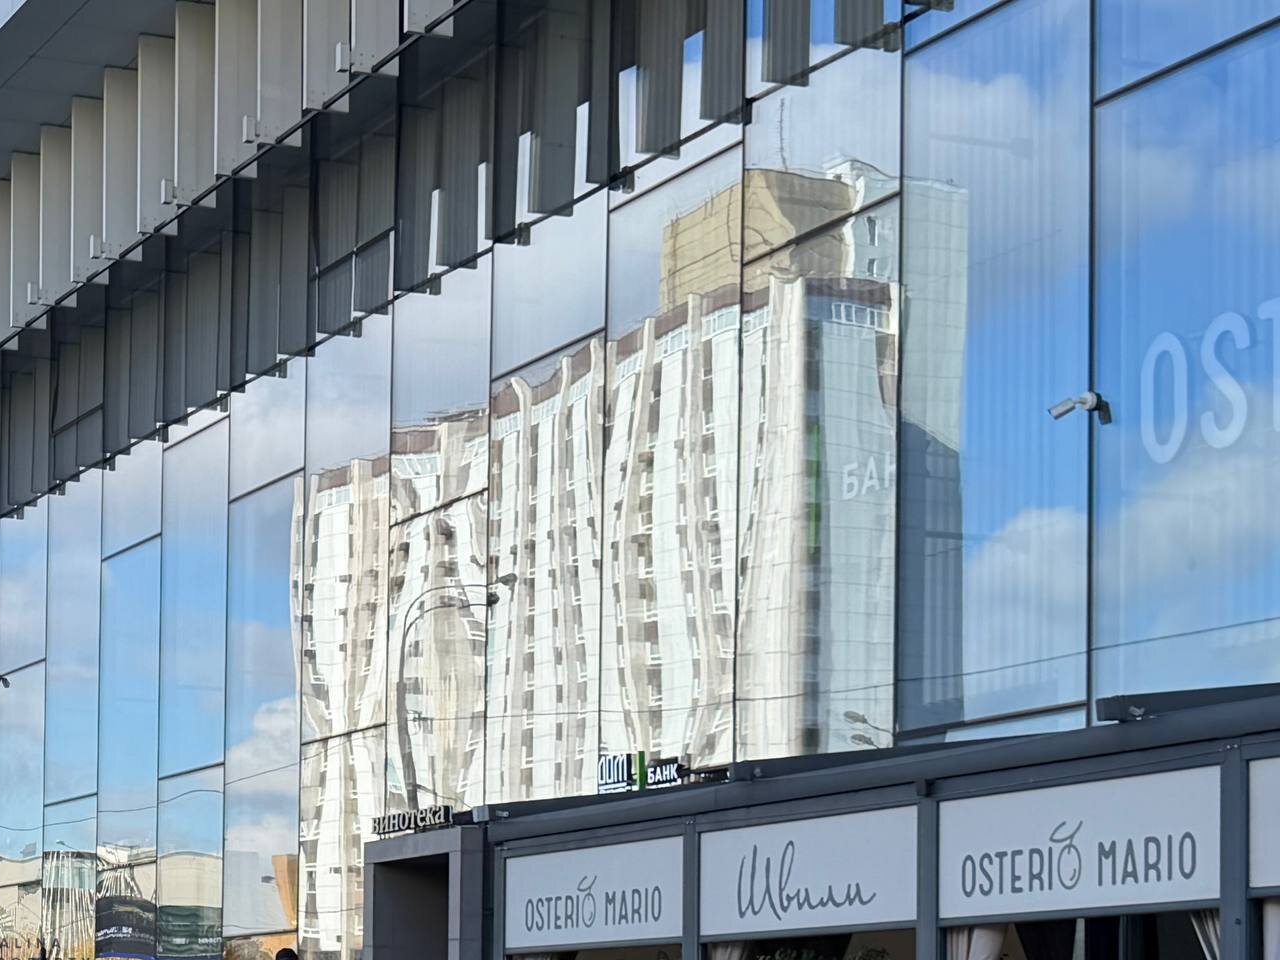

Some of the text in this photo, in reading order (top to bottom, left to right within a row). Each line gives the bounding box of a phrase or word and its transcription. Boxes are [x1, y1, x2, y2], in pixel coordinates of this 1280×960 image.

[647, 763, 678, 784] БАНК
[737, 840, 877, 921] Швили
[1097, 831, 1197, 887] MARIO
[605, 886, 662, 926] MARIO
